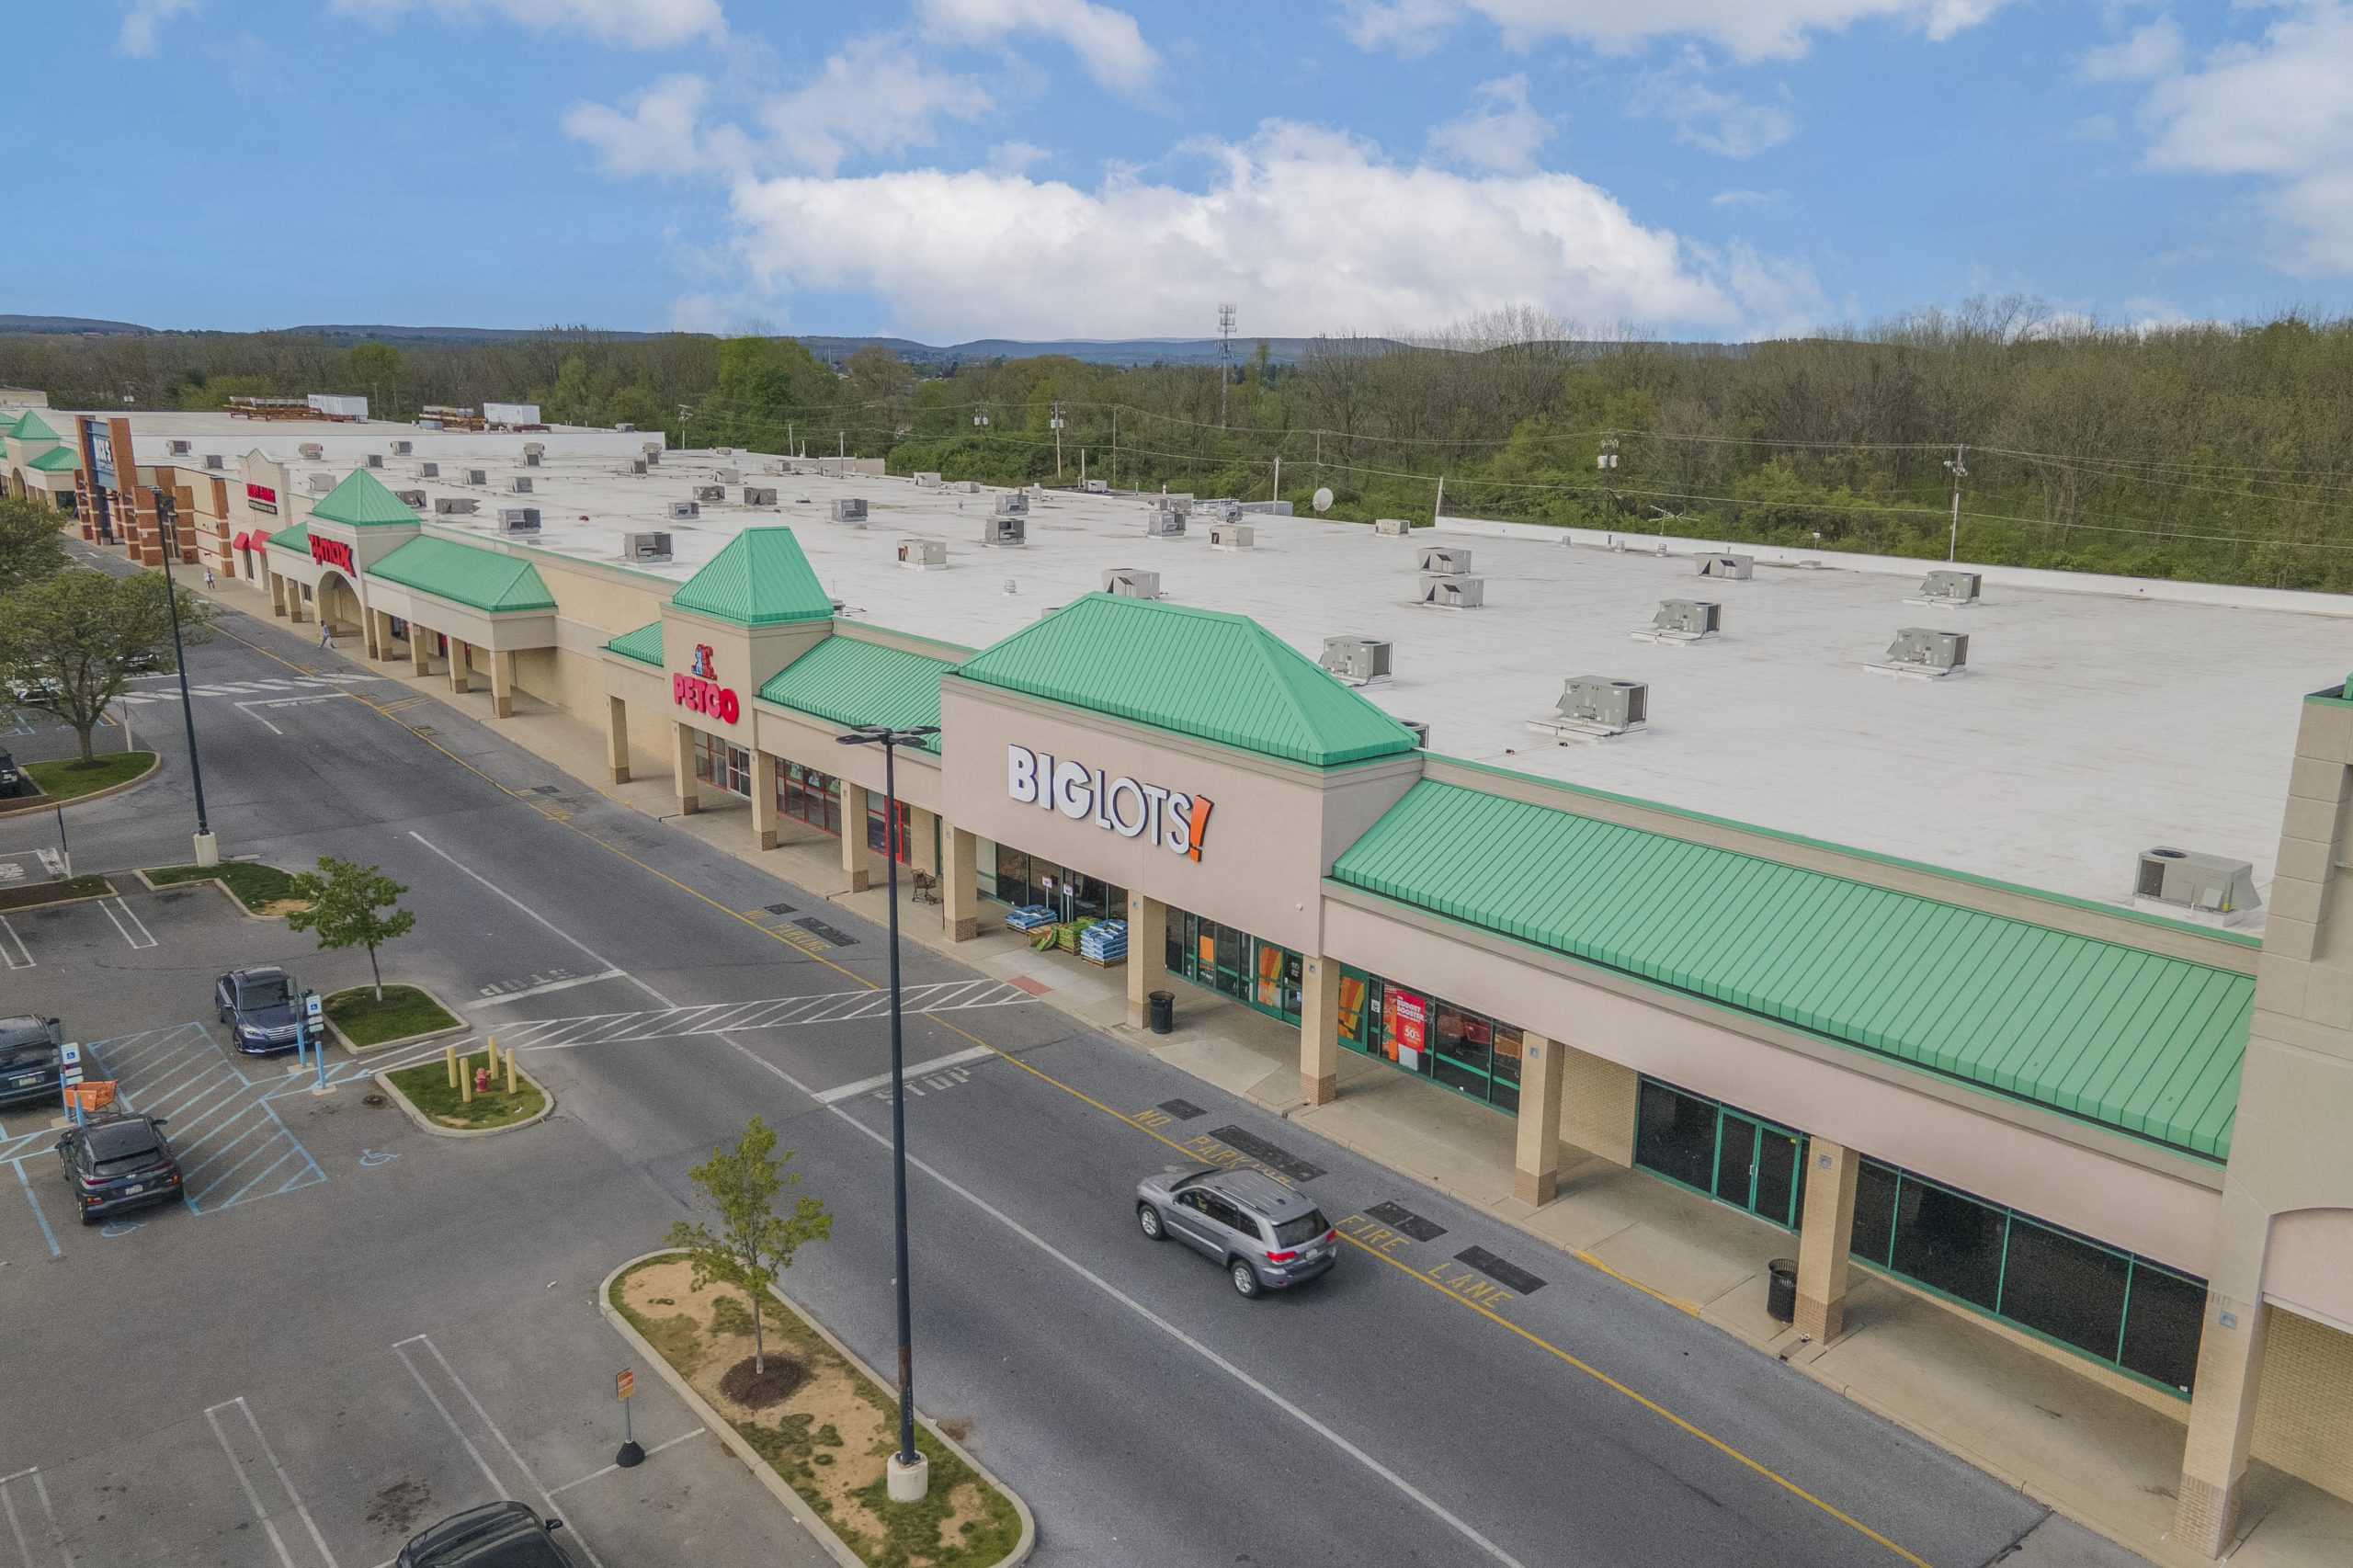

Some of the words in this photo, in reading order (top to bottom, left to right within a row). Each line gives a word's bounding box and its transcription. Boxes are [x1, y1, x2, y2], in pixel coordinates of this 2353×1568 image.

[673, 672, 739, 724] PETCO
[1007, 744, 1094, 819] BIG
[1095, 768, 1215, 862] LOTS!
[1396, 999, 1421, 1013] BUDGET
[1132, 1108, 1173, 1128] NO
[1336, 1214, 1410, 1253] FIRE
[1427, 1262, 1514, 1308] LANE
